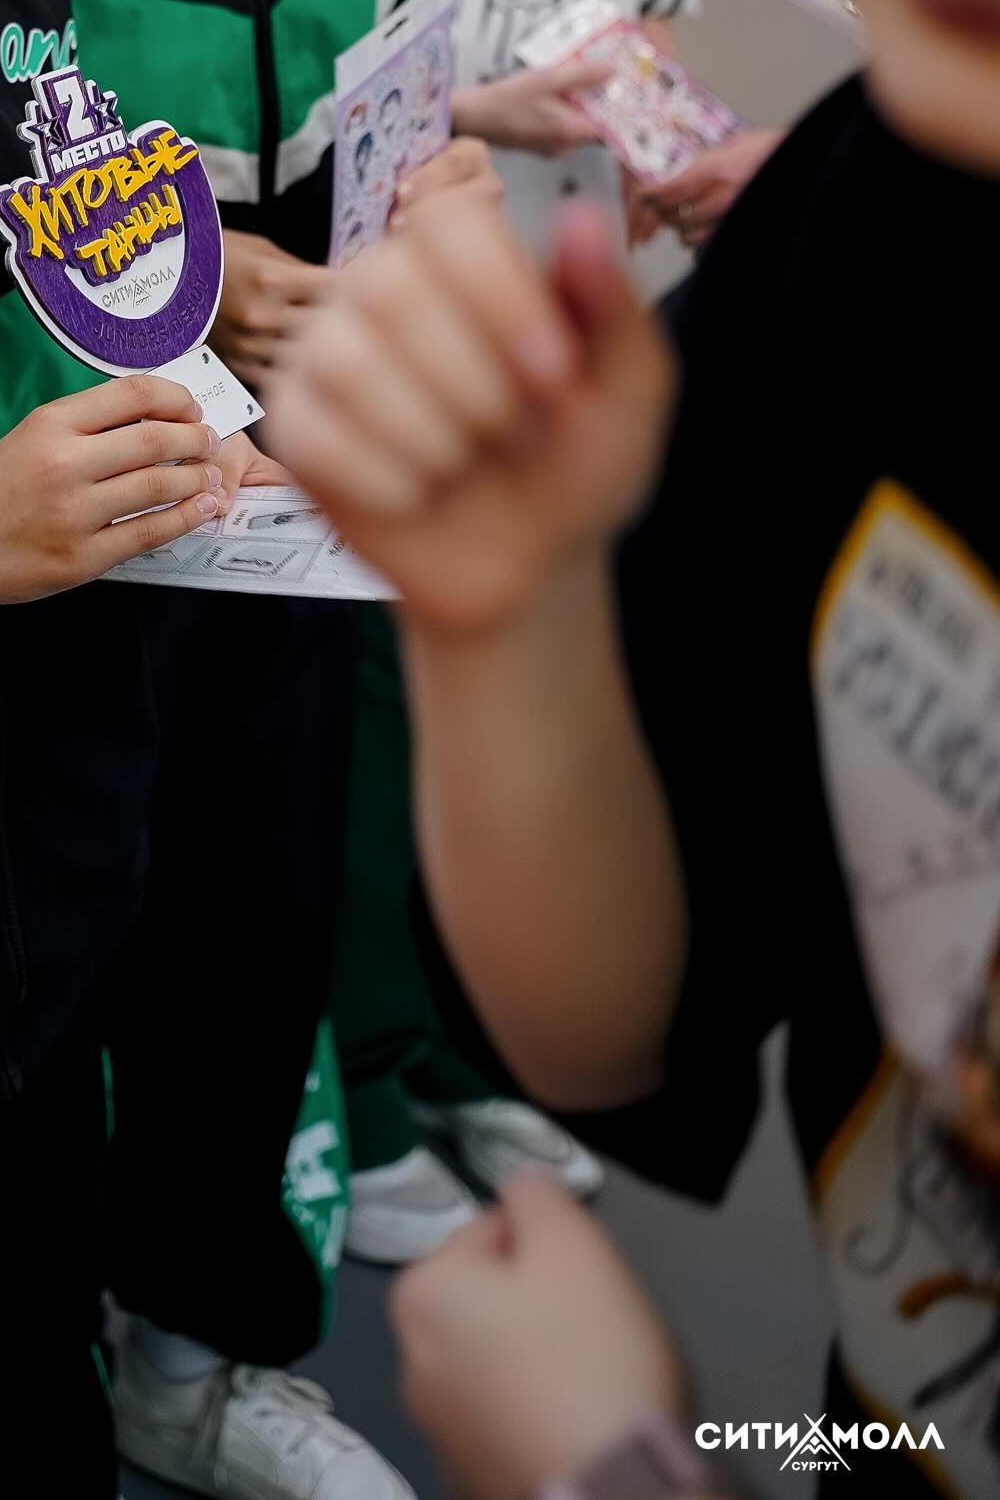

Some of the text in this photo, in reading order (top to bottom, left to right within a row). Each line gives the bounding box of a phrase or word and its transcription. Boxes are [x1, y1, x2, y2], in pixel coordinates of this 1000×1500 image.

[53, 76, 95, 140] 2
[50, 129, 126, 174] МЕСТО
[11, 129, 199, 260] ХИТОВЫЕ
[75, 184, 184, 277] ТАНЦЫ
